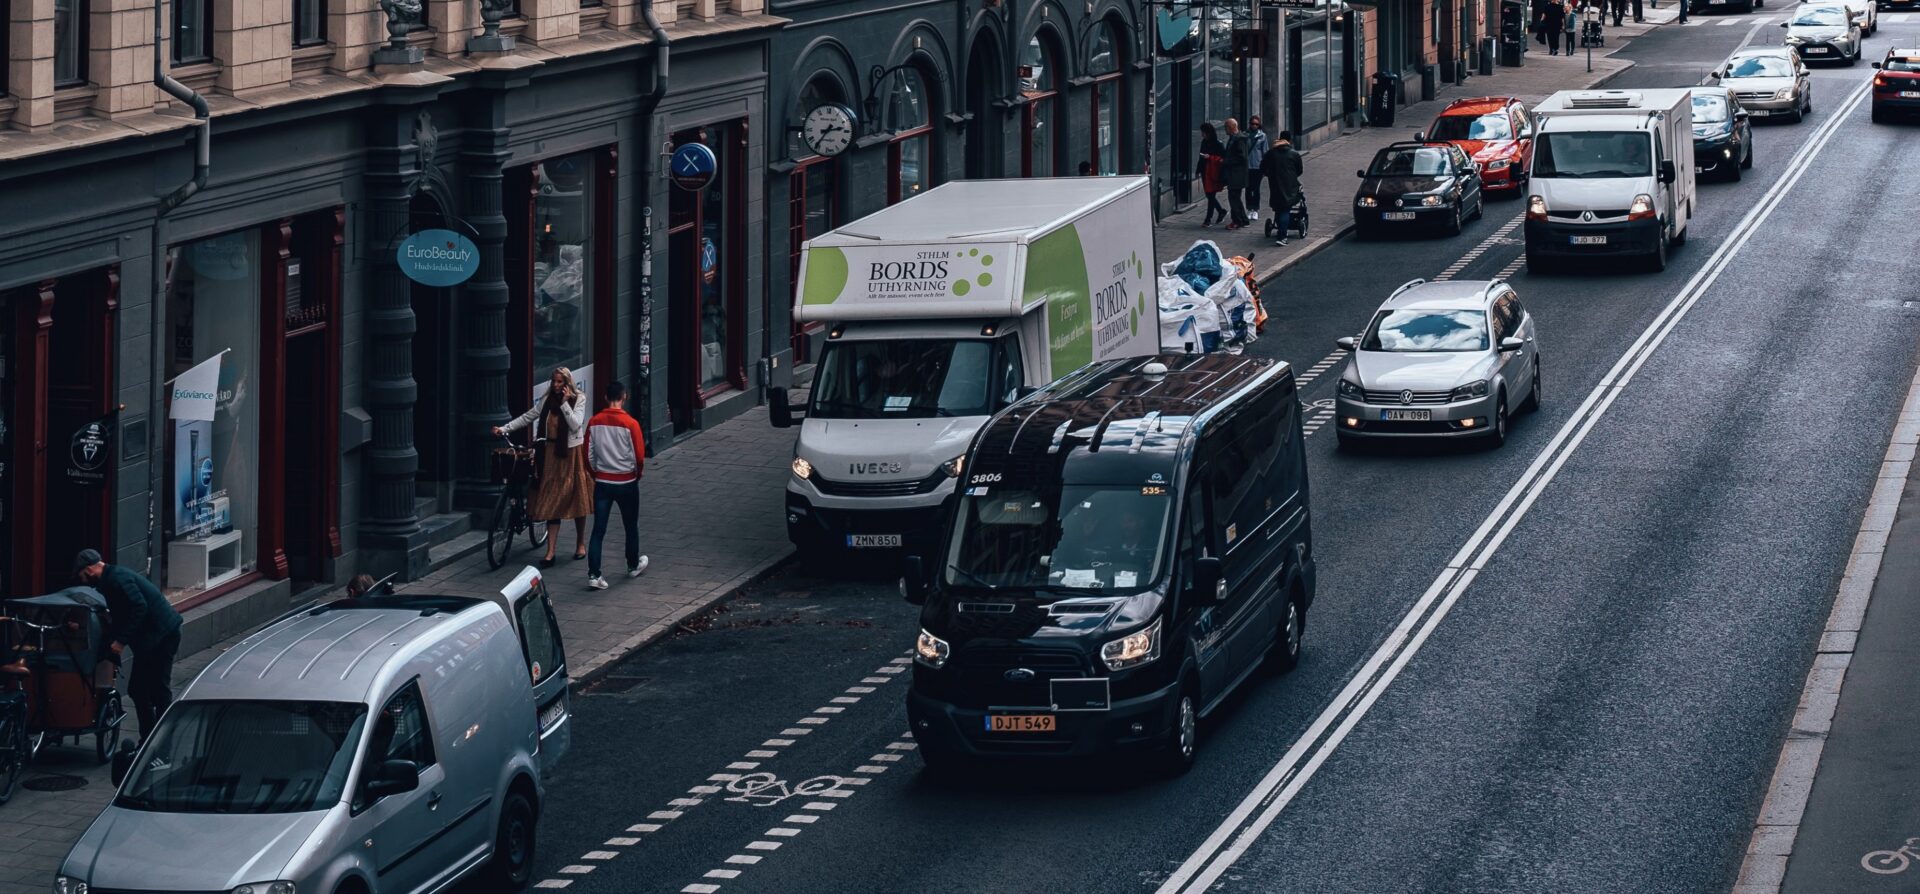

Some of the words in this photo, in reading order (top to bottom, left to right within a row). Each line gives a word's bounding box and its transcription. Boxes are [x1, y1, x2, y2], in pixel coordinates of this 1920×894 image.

[407, 245, 471, 262] EuroBeauty
[916, 251, 950, 260] STHLM
[868, 260, 949, 281] BORDS
[868, 281, 947, 293] UTHYRNING
[1095, 276, 1128, 325] BORDS
[1097, 312, 1129, 347] UTHYRNING
[174, 389, 214, 400] Exuviance
[1410, 411, 1429, 420] 098
[849, 462, 901, 475] IVECO
[971, 472, 1002, 484] 3806
[855, 536, 875, 546] ZMN
[877, 536, 898, 546] 850
[995, 717, 1021, 730] DJT
[1024, 717, 1051, 730] 549
